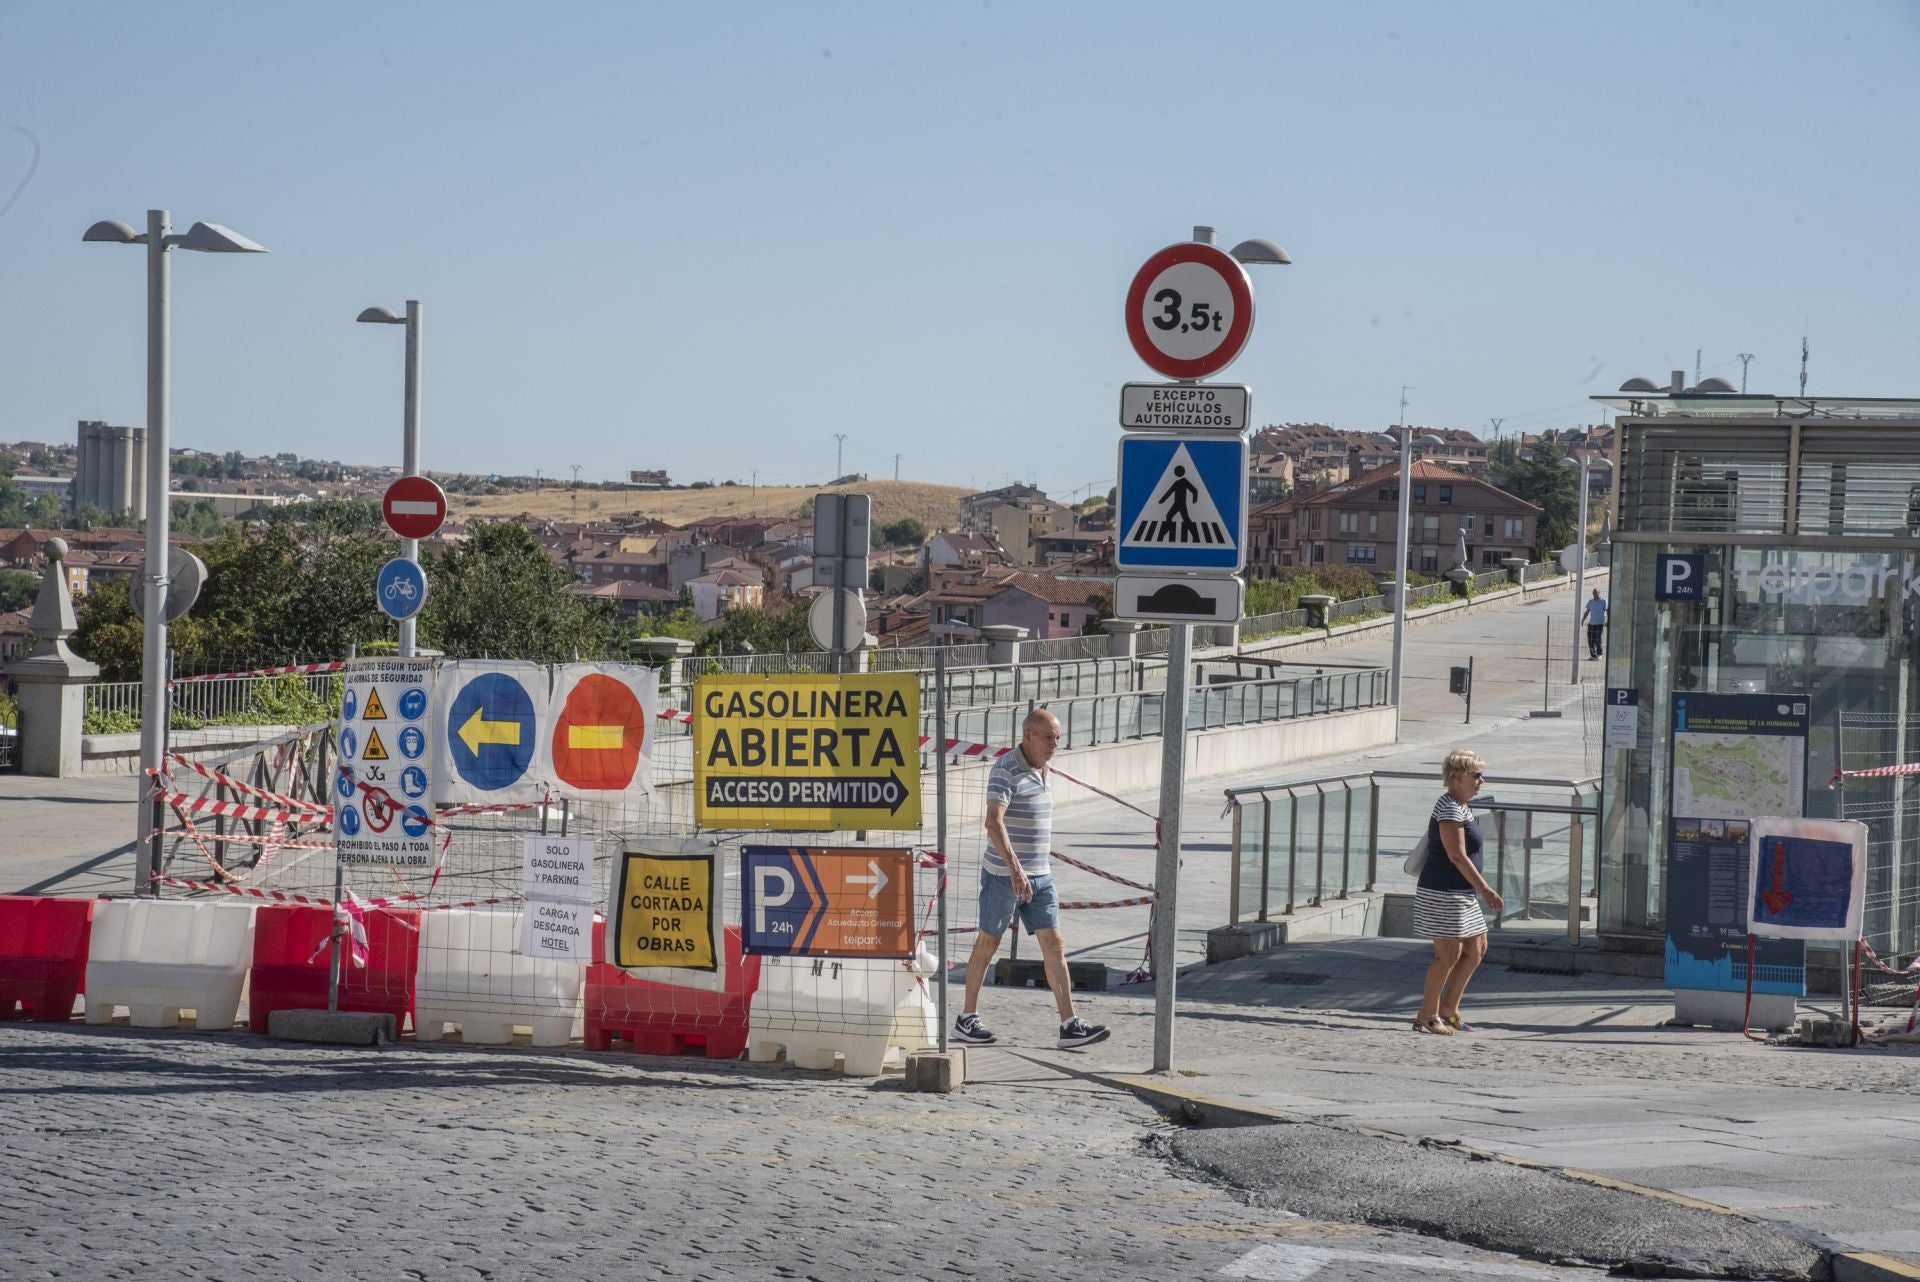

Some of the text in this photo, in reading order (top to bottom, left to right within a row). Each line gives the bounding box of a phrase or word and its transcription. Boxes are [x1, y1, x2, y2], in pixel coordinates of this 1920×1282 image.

[1152, 288, 1223, 334] 3,5t
[1153, 390, 1215, 401] EXCEPTO
[1146, 401, 1222, 413] VEHÍCULOS
[1135, 413, 1232, 426] AUTORIZADOS
[1665, 559, 1692, 594] P
[1676, 586, 1693, 594] 24h
[376, 662, 405, 671] SEGUIR
[408, 663, 430, 671] TODAS
[371, 674, 379, 683] DE
[380, 673, 423, 683] SEGURIDAD
[705, 690, 908, 718] GASOLINERA
[1766, 720, 1800, 728] HUMANIDAD
[707, 728, 906, 767] ABIERTA
[710, 781, 898, 803] ACCESO PERMITIDO
[337, 840, 430, 851] PROHIBIDO EL PASO A TODA
[546, 845, 570, 855] SOLO
[337, 854, 369, 863] PERSONA
[371, 855, 388, 863] AJENA
[396, 855, 405, 864] LA
[407, 855, 427, 864] OBRA
[531, 859, 585, 871] GASOLINERA
[535, 873, 579, 885] Y PARKING
[643, 875, 691, 891] CALLE
[630, 895, 704, 911] CORTADA
[754, 865, 796, 933] P
[539, 907, 578, 920] CARGA Y
[850, 909, 879, 917] Acceso
[533, 920, 580, 936] DESCARGA
[652, 917, 681, 932] POR
[772, 920, 794, 934] 24h
[827, 919, 902, 928] Acueducto Oriental
[541, 937, 570, 950] HOTEL
[637, 936, 695, 952] OBRAS
[844, 935, 882, 947] telpark
